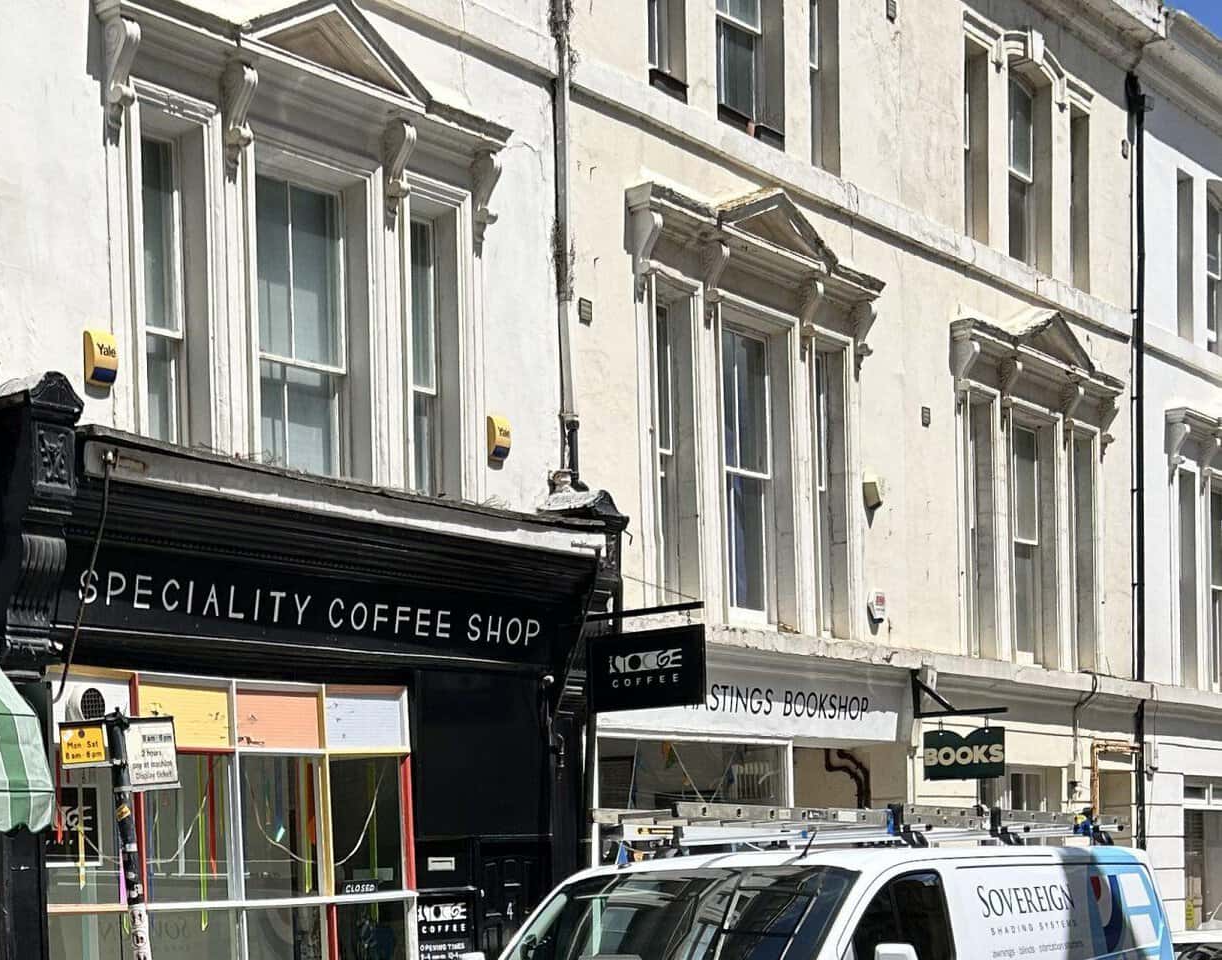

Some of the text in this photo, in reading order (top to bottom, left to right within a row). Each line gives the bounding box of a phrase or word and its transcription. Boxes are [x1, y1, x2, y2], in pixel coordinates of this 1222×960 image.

[96, 342, 116, 358] Yale
[78, 569, 541, 647] SPECIALITY COFFEE SHOP
[611, 673, 680, 689] COFFEE
[783, 689, 870, 721] BOOKSHOP
[66, 740, 99, 750] Mon Sat
[923, 743, 1005, 767] BOOKS
[345, 884, 376, 893] CLOSED
[976, 883, 1076, 918] SOVEREIGN
[506, 902, 514, 920] 4
[421, 923, 466, 934] COFFEE
[990, 923, 1034, 936] SHADING
